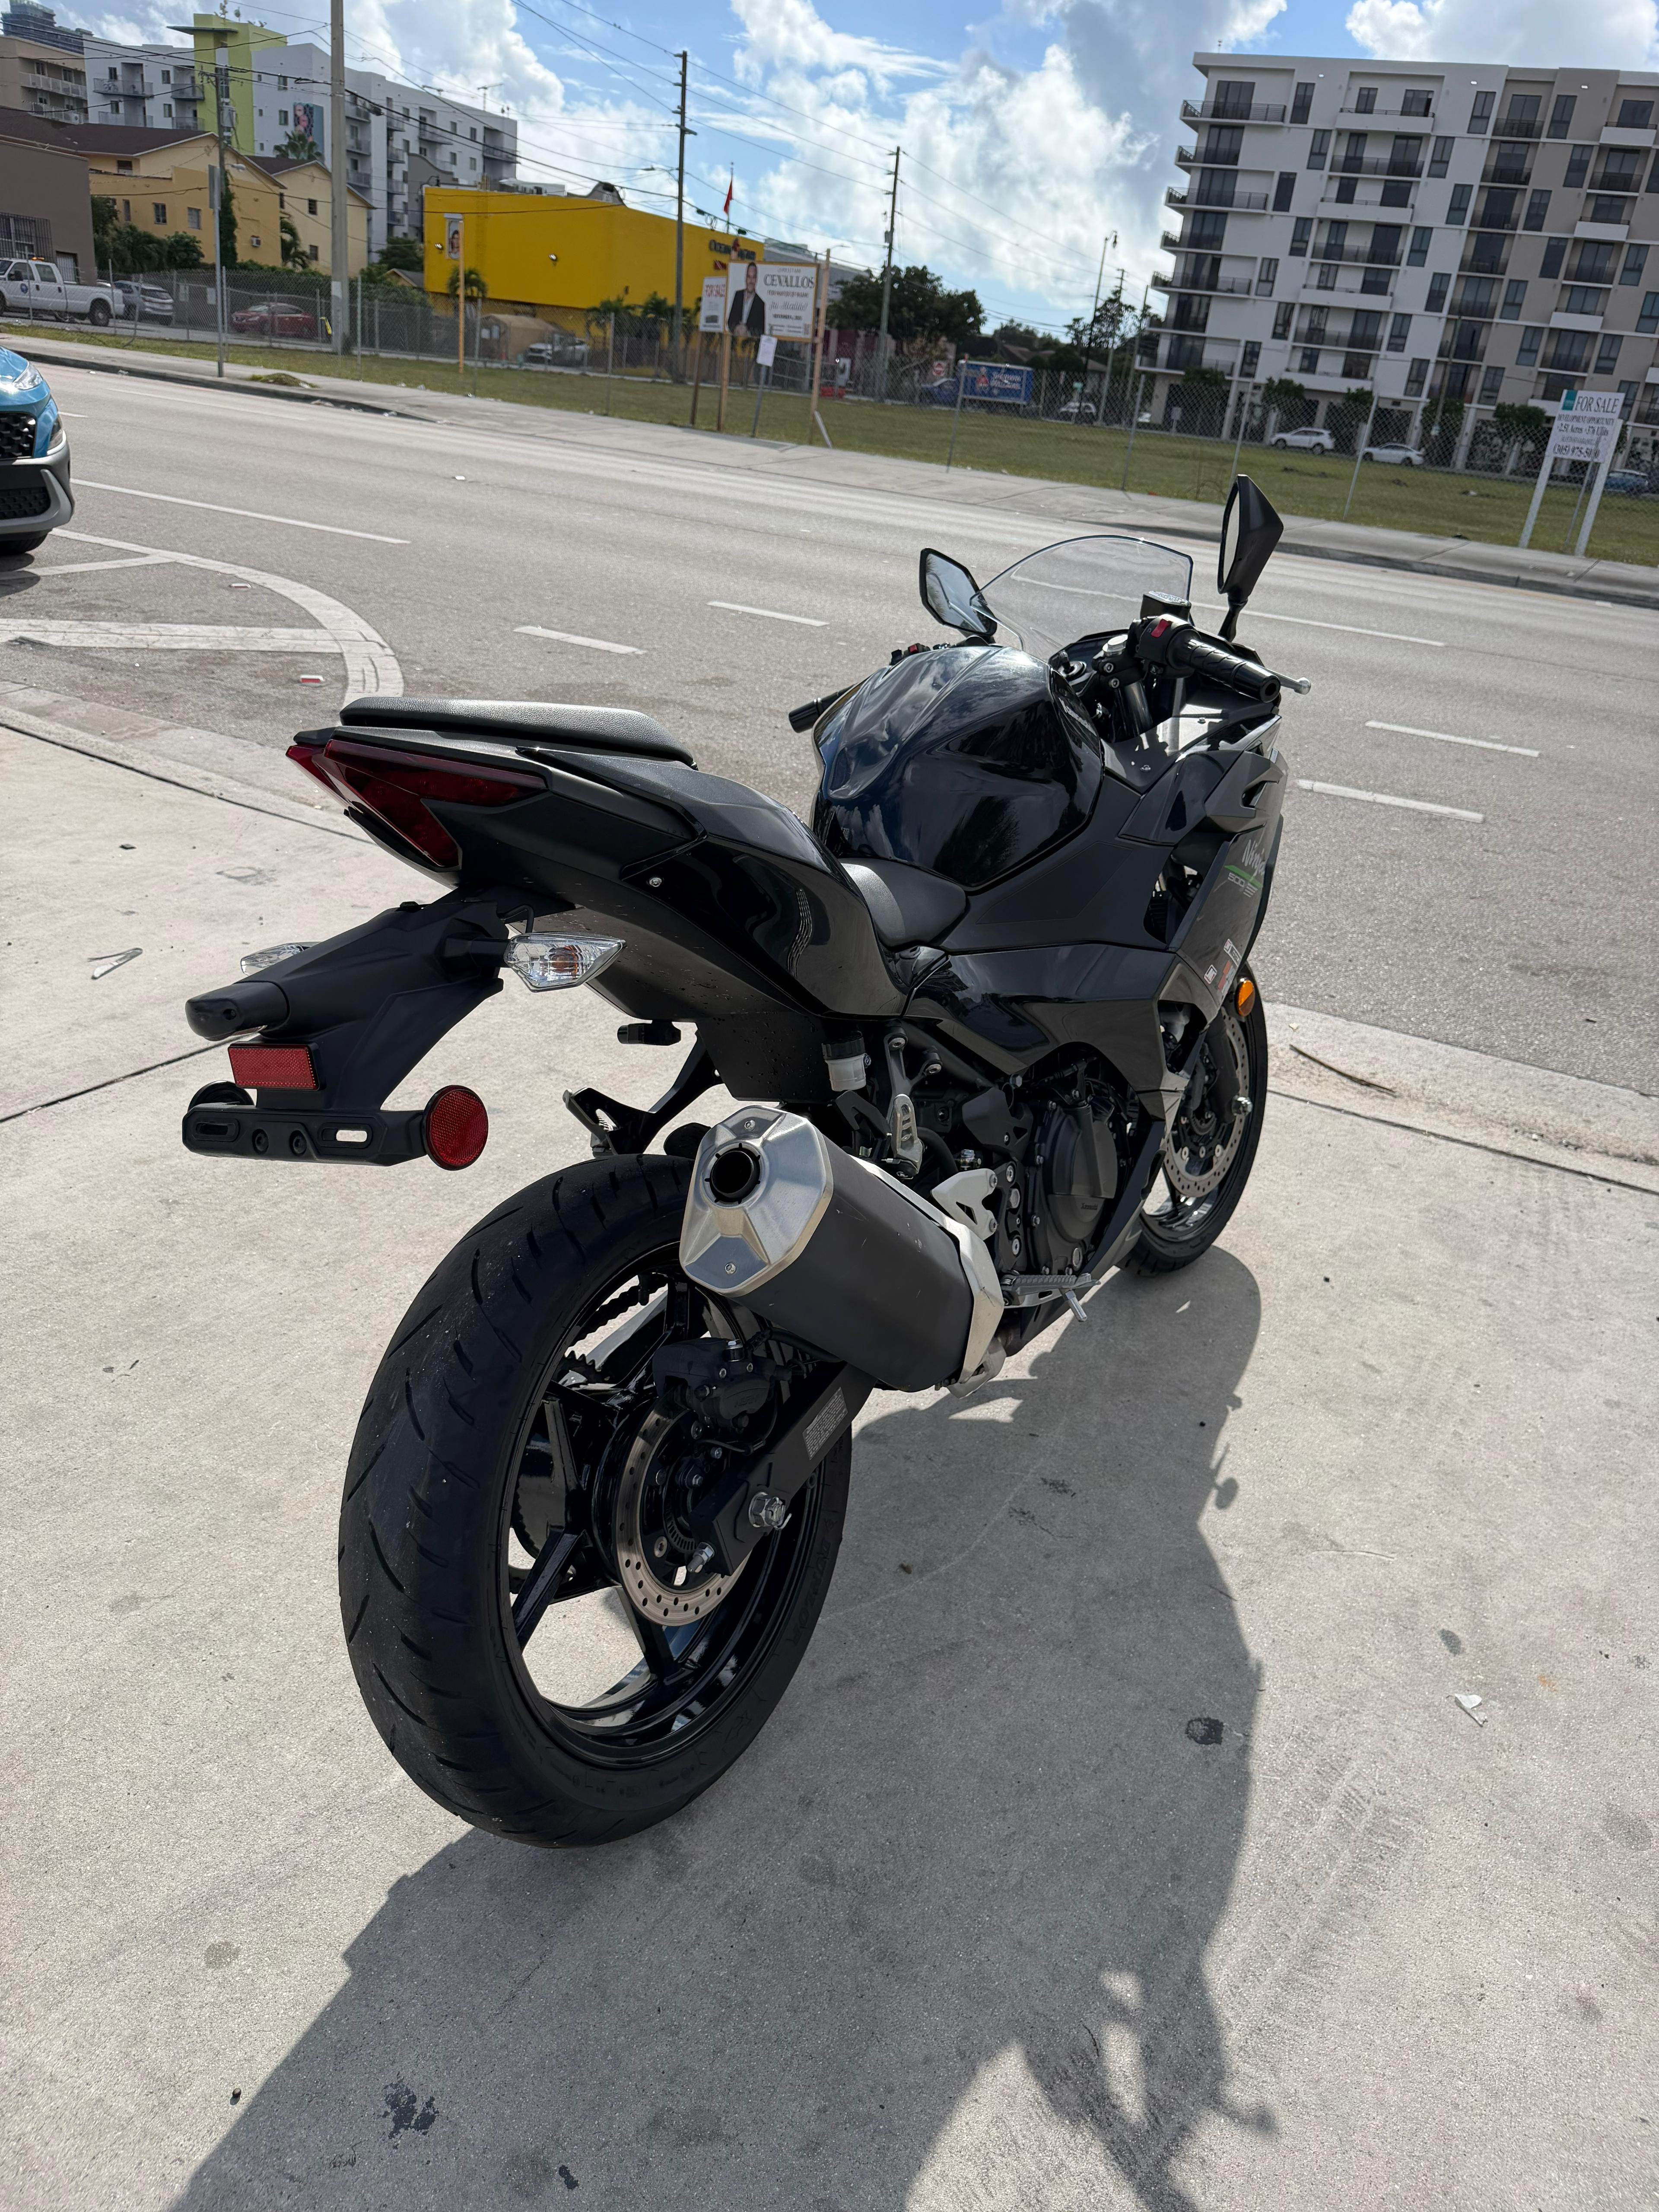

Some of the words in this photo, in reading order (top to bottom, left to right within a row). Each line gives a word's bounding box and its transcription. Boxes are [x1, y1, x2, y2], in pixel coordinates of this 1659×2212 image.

[763, 273, 815, 289] CEVALLOS
[1574, 396, 1594, 412] FOR
[1594, 397, 1620, 414] SALE
[1241, 839, 1266, 882] Ninja
[1228, 872, 1246, 888] 500
